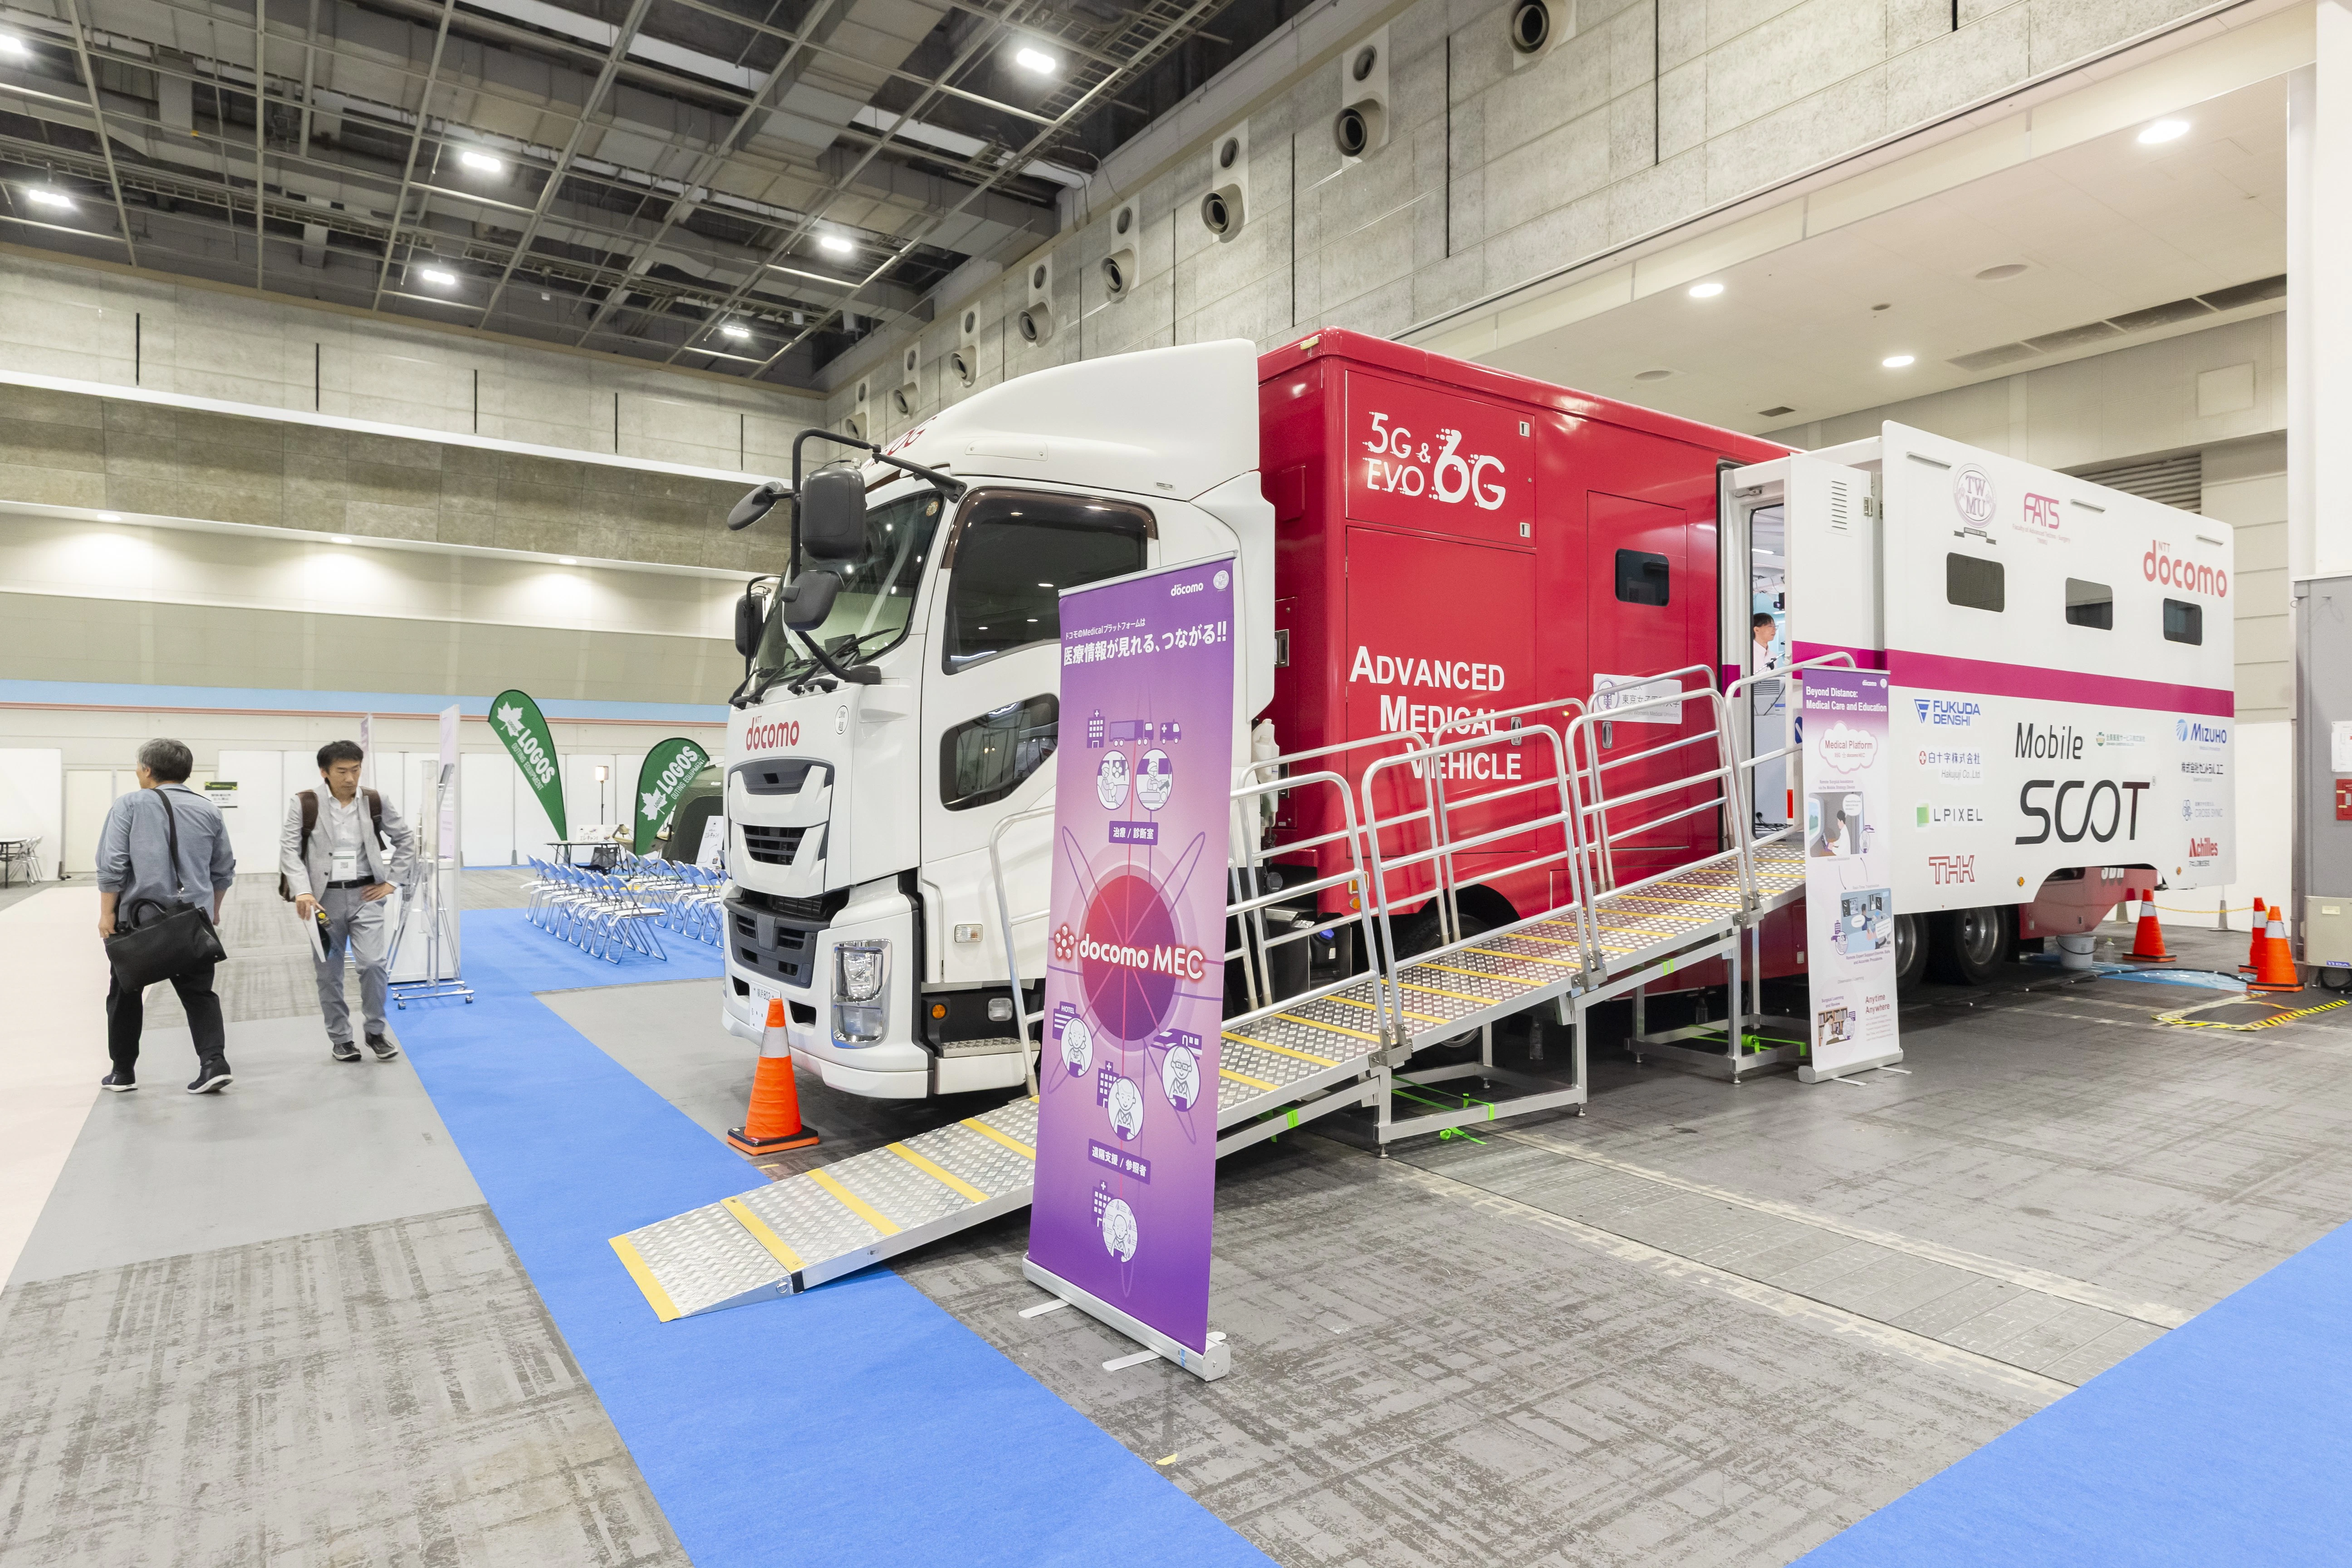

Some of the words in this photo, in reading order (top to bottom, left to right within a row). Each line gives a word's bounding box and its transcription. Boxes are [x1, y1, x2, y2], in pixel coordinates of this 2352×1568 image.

[1362, 412, 1411, 458] 5G
[1416, 443, 1431, 463] &
[1362, 457, 1424, 496] EVO
[1429, 429, 1506, 510] 6G
[2024, 492, 2059, 529] FATS
[2158, 541, 2171, 553] NTT
[2143, 539, 2227, 598] docomo
[1171, 583, 1204, 596] docomo
[1349, 646, 1505, 691] ADVANCED
[1806, 686, 1829, 698] Beyond
[1831, 687, 1858, 698] Distance:
[1806, 700, 1830, 710] Medical
[1831, 701, 1845, 710] Care
[1847, 702, 1857, 710] and
[1858, 702, 1887, 712] Education
[1933, 700, 1981, 715] FUKUDA
[1380, 695, 1504, 735] MEDICAL
[1933, 714, 1970, 726] DENSHI
[746, 717, 799, 751] docomo
[1825, 740, 1847, 749] Medical
[1849, 740, 1872, 749] Platform
[2015, 722, 2083, 760] Mobile
[2190, 723, 2227, 744] MIZUHO
[511, 742, 527, 763] OUTING
[523, 761, 544, 791] EQUIPMENT
[517, 729, 555, 784] LOGOS
[656, 746, 698, 794] LOGOS
[1406, 743, 1521, 779] VEHICLE
[1929, 751, 1980, 764] 白十字株式会社
[670, 782, 686, 800] OUTING
[682, 758, 705, 783] EQUIPMENT
[1933, 808, 1983, 823] LPIXEL
[2015, 779, 2151, 845] SCOT
[1113, 827, 1126, 838] 治療
[1133, 828, 1154, 839] 診断室
[2189, 838, 2218, 857] Achilles
[1929, 855, 1975, 885] THK
[1079, 933, 1149, 969] docomo
[1153, 944, 1204, 980] MEC
[1061, 1005, 1074, 1014] HOTEL
[1865, 994, 1886, 1004] Anytime
[1866, 1004, 1890, 1014] Anywhere
[1092, 1146, 1118, 1166] 遠隔支援
[1126, 1159, 1147, 1177] 参照者
